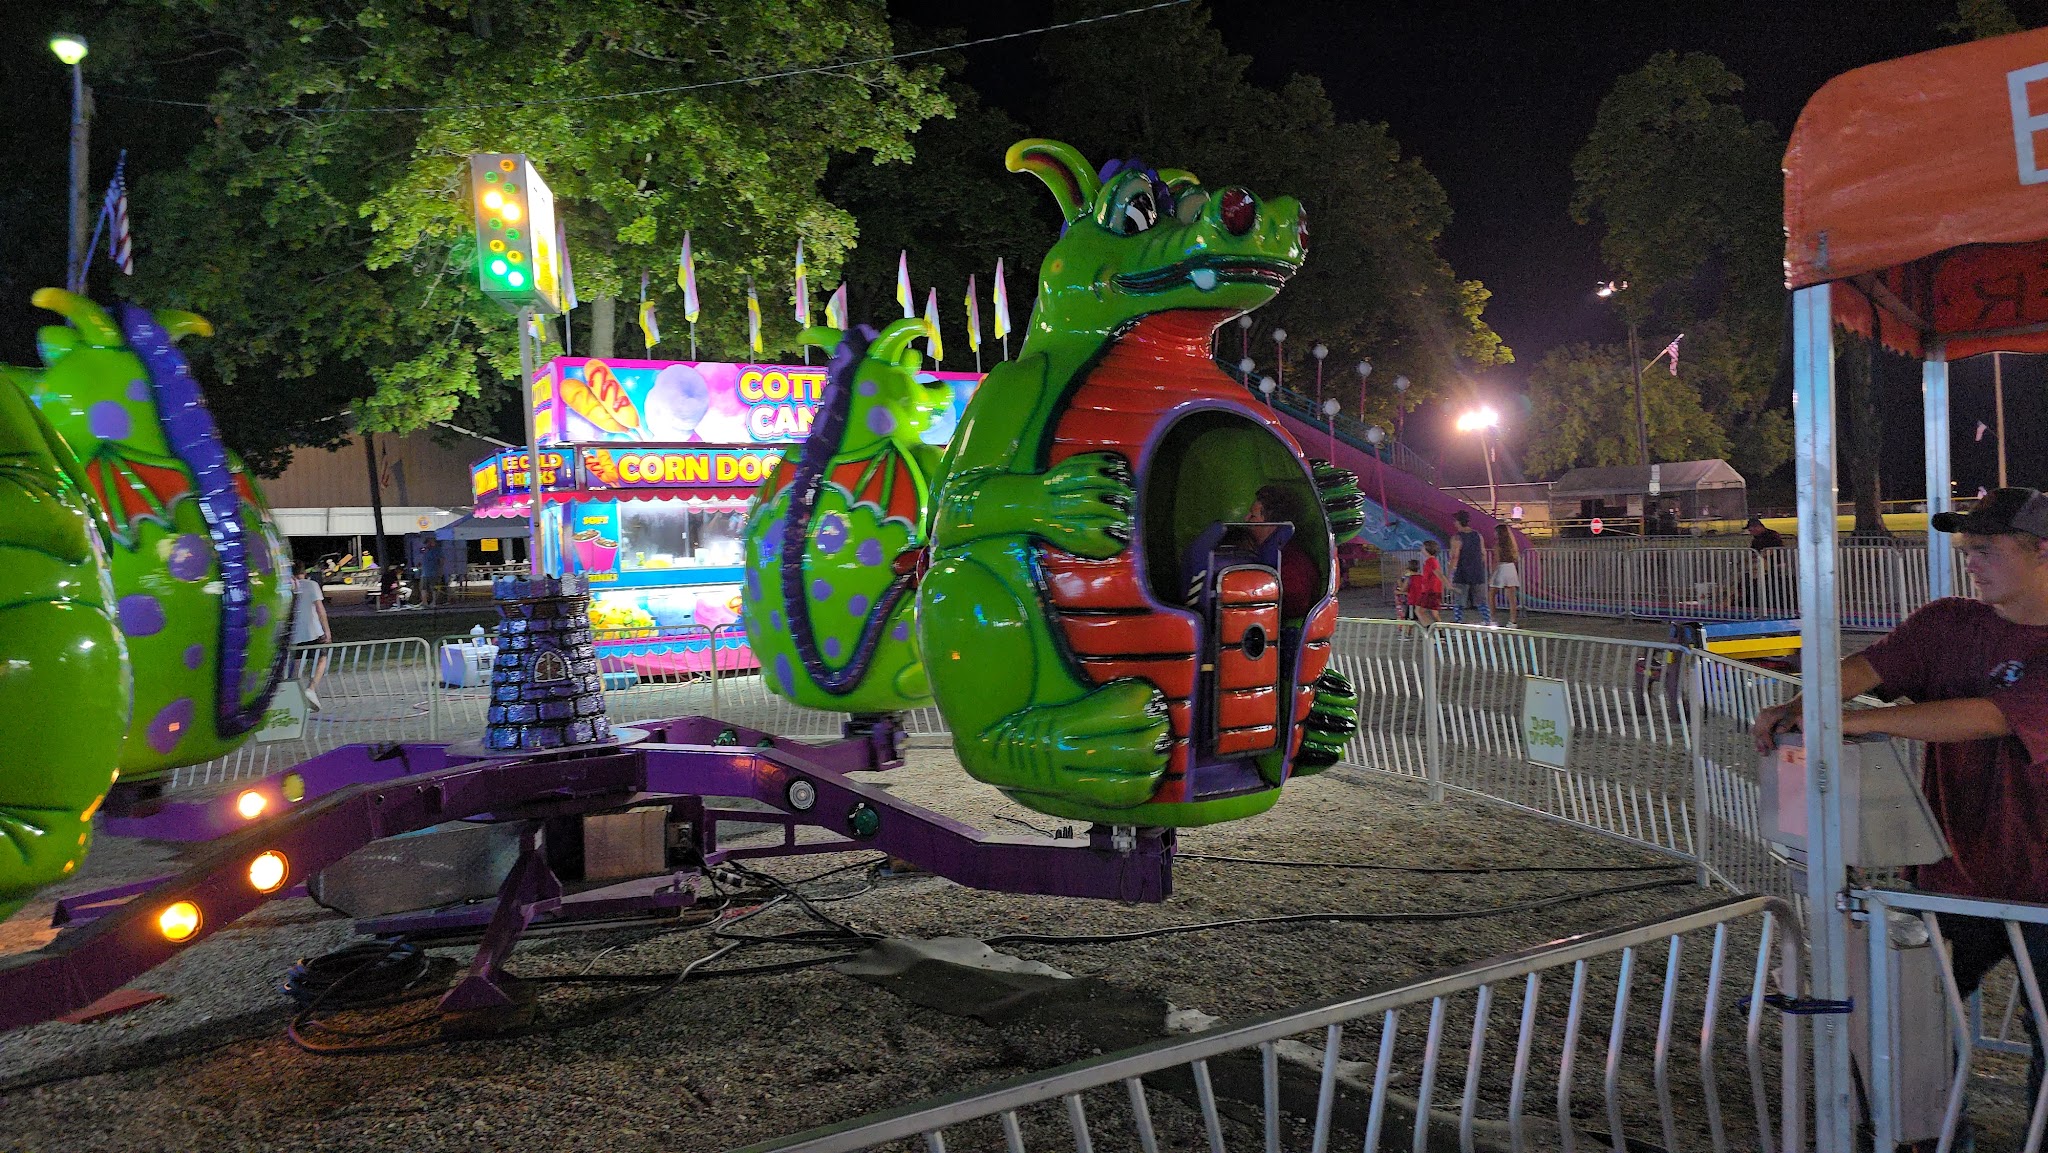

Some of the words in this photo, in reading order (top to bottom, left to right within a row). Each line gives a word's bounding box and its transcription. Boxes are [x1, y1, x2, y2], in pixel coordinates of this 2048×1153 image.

[739, 370, 827, 400] COTT
[750, 405, 816, 435] CAN
[519, 453, 563, 471] CLD
[618, 454, 709, 482] CORN
[716, 454, 782, 482] DOG
[506, 470, 556, 487] DRIKS
